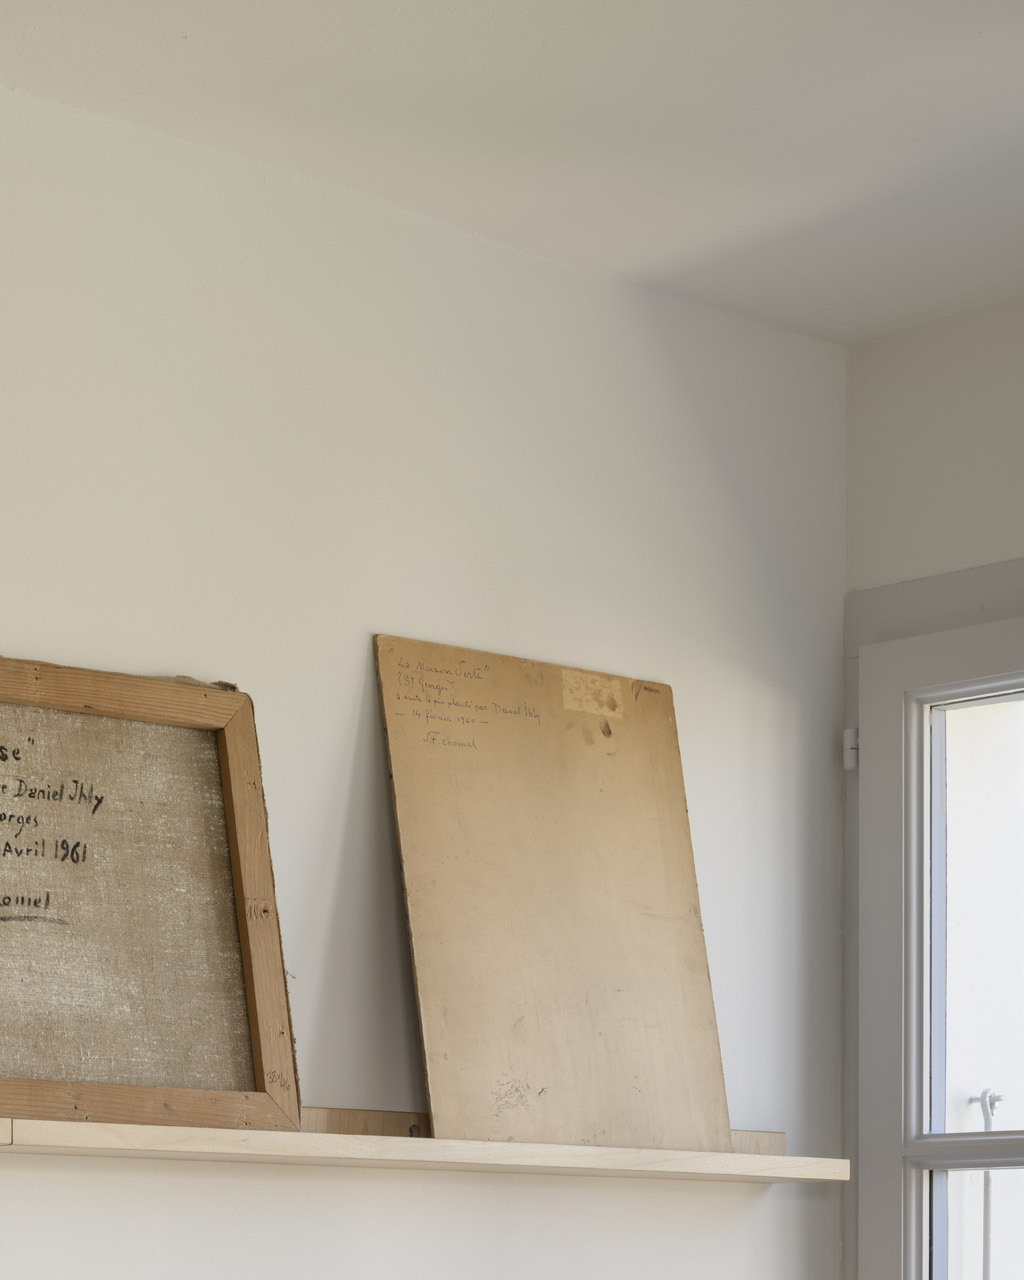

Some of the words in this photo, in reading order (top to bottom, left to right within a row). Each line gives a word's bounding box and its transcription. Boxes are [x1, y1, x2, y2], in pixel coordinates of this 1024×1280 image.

[13, 778, 64, 802] Daniel
[2, 839, 46, 858] Avril
[54, 838, 88, 864] 1961
